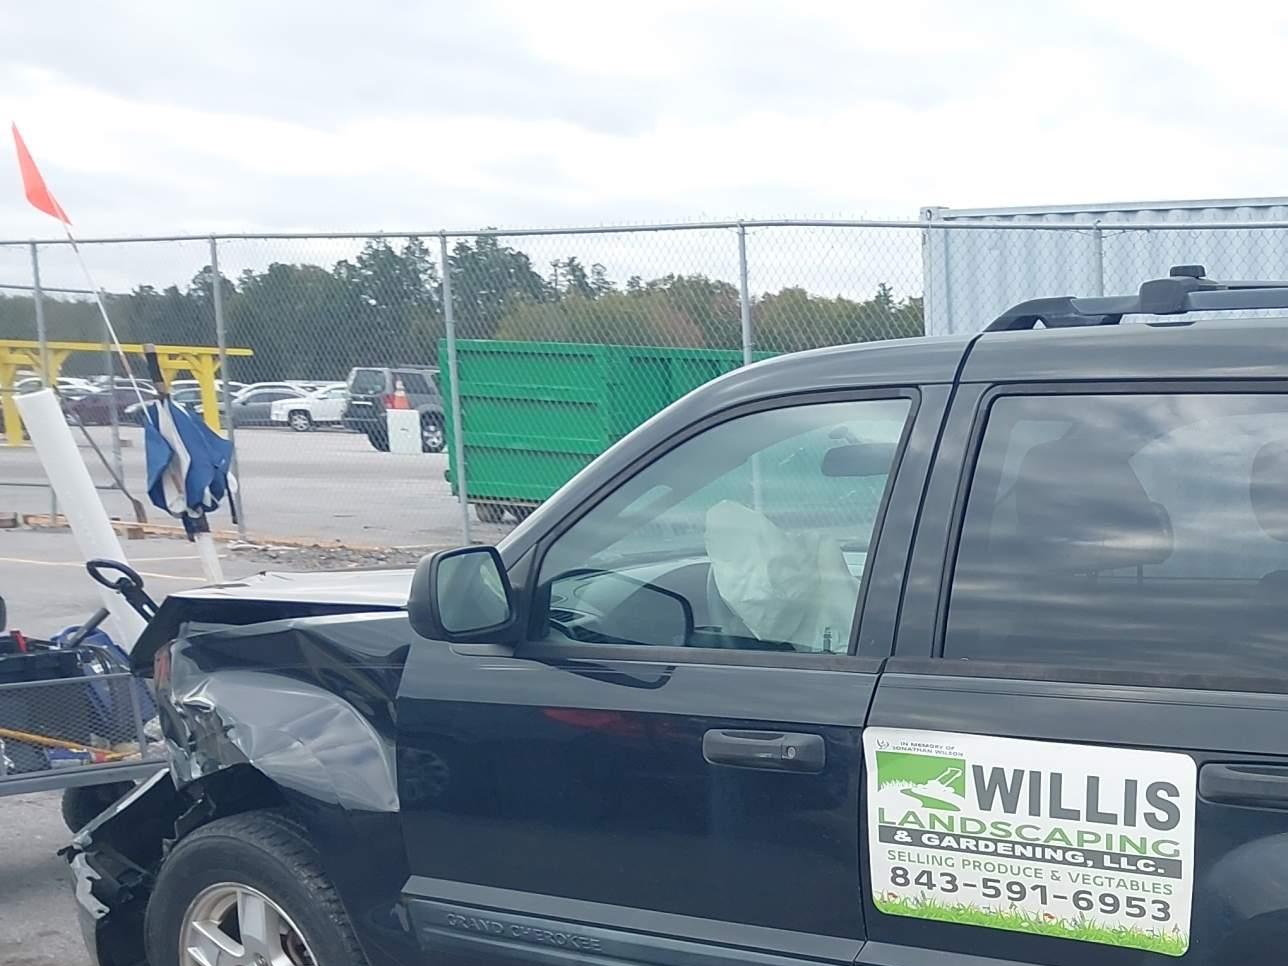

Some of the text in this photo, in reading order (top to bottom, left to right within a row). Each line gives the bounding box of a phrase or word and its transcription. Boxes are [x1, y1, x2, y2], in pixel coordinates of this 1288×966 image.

[971, 764, 1181, 831] WILLIS
[878, 807, 1180, 858] LANDSCAPING
[893, 829, 1165, 874] & GARDENING, LLC.
[887, 849, 1173, 896] SELLING PRODUCE & VEGTABLES
[890, 865, 1172, 922] 843-591-6953
[447, 912, 603, 951] GRAND CHEROKEE
